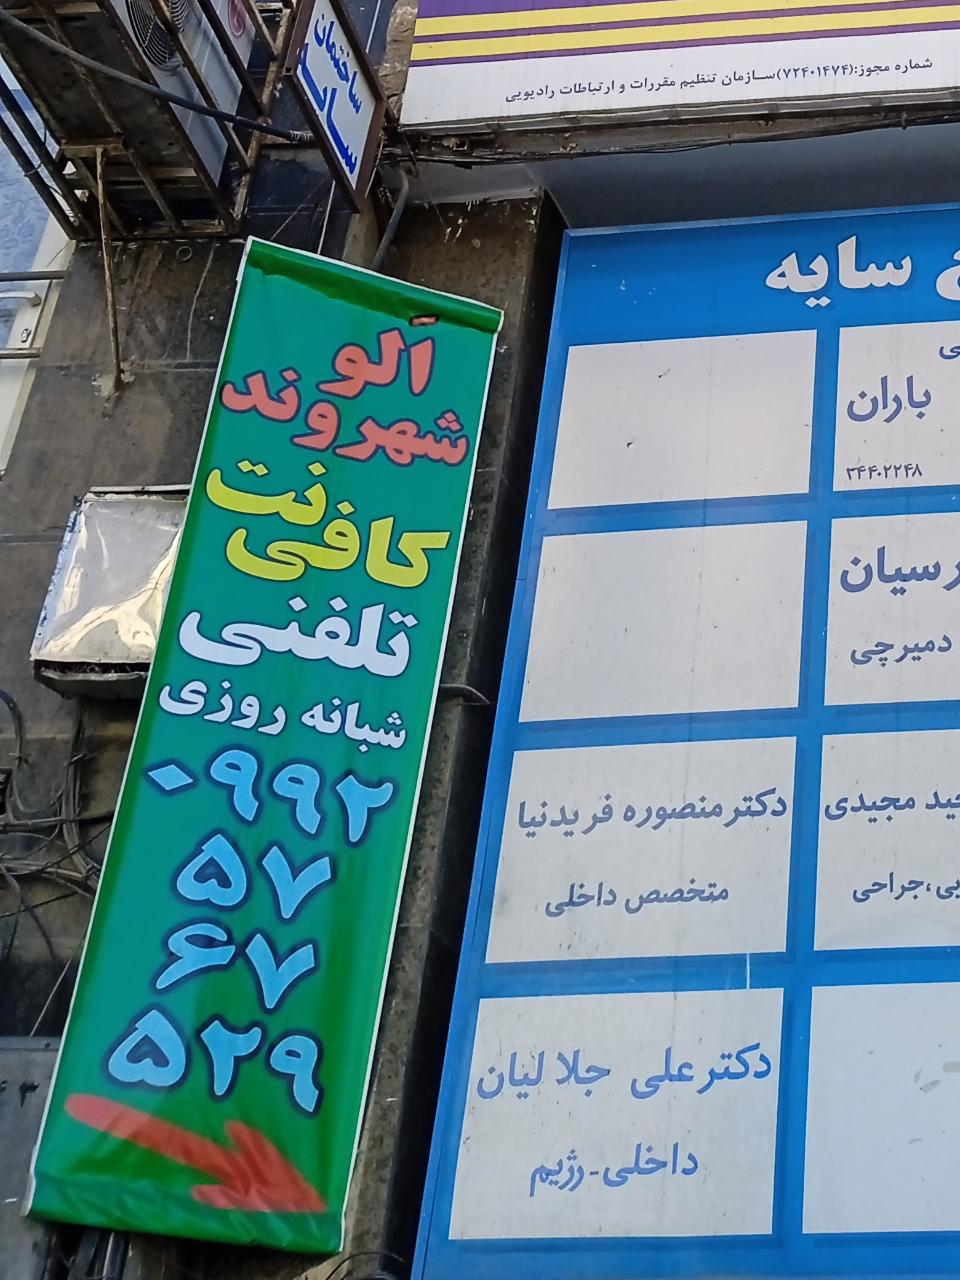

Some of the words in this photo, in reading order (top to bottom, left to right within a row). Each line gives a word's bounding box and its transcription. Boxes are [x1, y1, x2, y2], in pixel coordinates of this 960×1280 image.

[313, 13, 363, 115] ساختمان
[559, 79, 616, 96] ارتباطات
[619, 83, 626, 94] و
[630, 76, 676, 91] مقررات
[680, 72, 716, 90] تنظیم
[894, 57, 933, 72] شماره
[505, 84, 555, 102] رادیویی
[765, 234, 914, 309] سایه
[220, 368, 470, 467] شهروند
[846, 375, 932, 424] باران
[205, 461, 329, 526] نت
[225, 501, 453, 589] کافی
[177, 595, 420, 678] تلفنی
[850, 634, 952, 667] دمیرچی
[158, 677, 287, 735] روزی
[299, 696, 409, 754] شبانه
[144, 747, 396, 845] ۰۹۹۲
[517, 793, 614, 839] فریدنیا
[623, 795, 723, 831] منصوره
[723, 787, 788, 828] دکتر
[824, 792, 916, 824] مجیدی
[173, 831, 334, 921] ۵۷
[545, 881, 617, 918] داخلی
[624, 878, 729, 914] متخصص
[153, 920, 317, 1012] ۶۷
[105, 1007, 323, 1115] ۵۲۹
[630, 1046, 695, 1100] علی
[696, 1041, 773, 1095] دکتر
